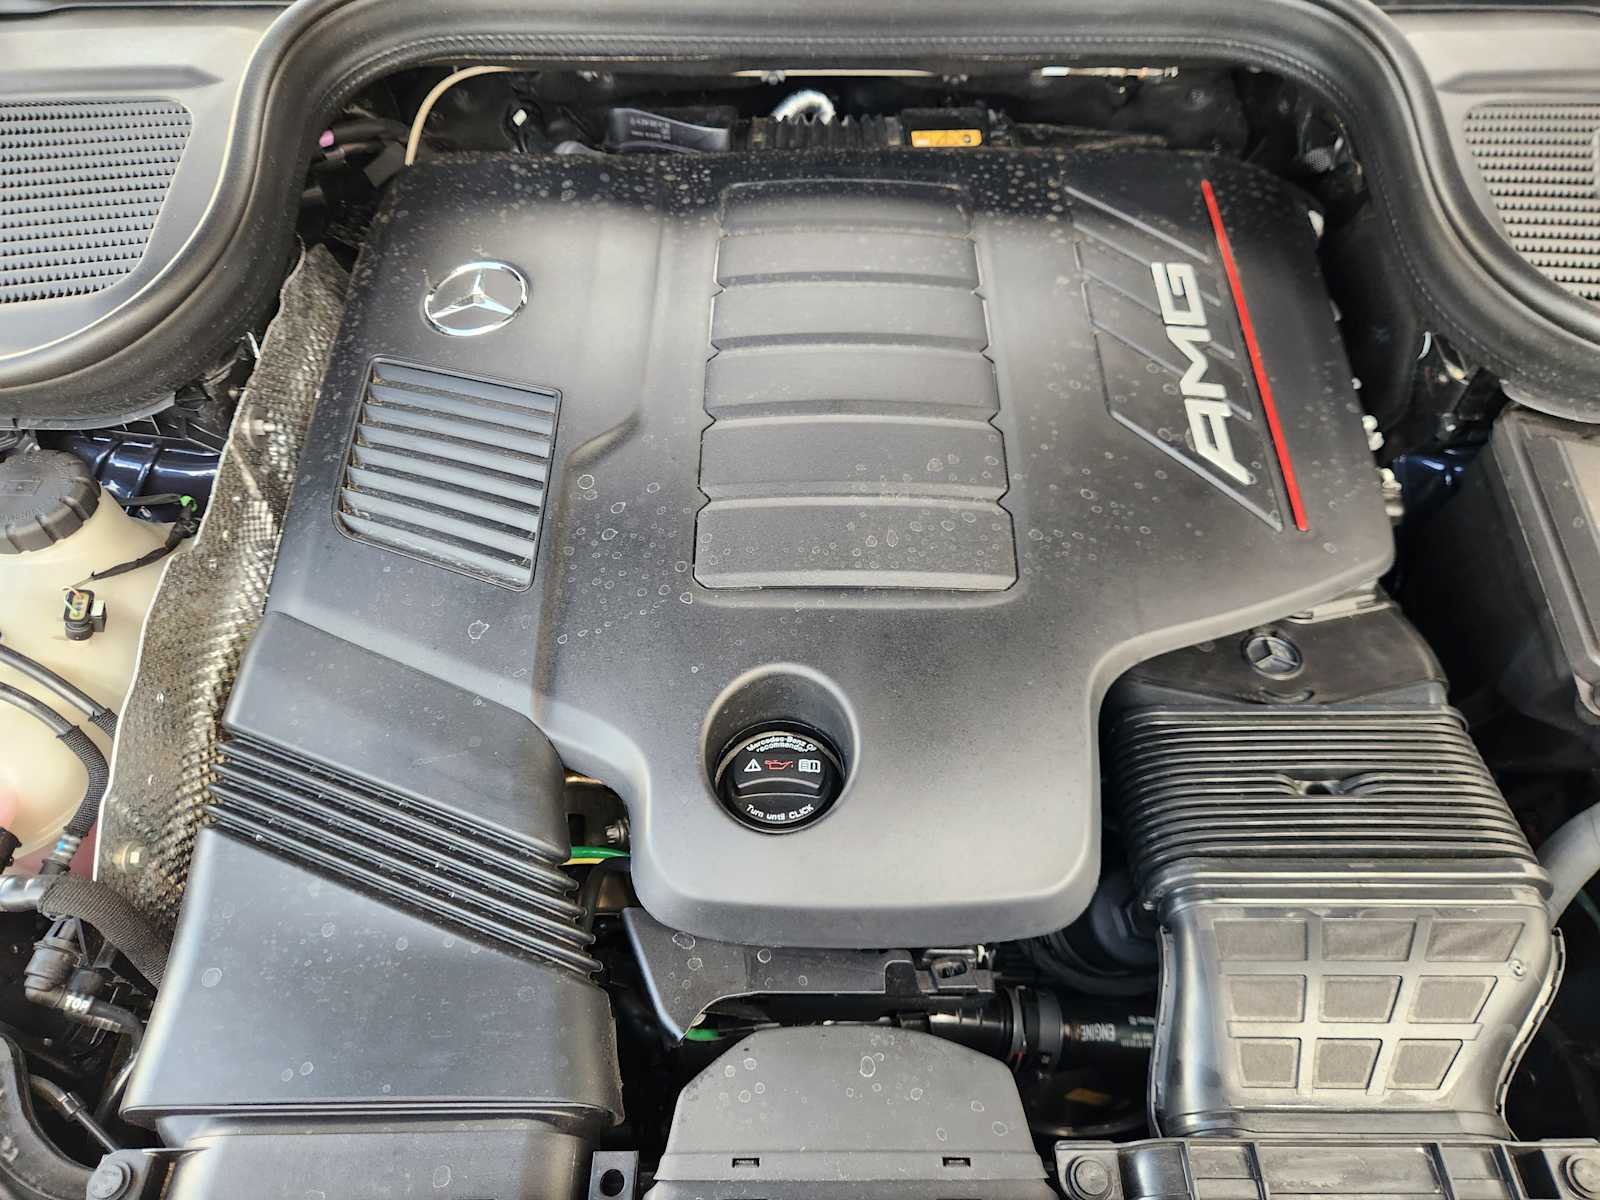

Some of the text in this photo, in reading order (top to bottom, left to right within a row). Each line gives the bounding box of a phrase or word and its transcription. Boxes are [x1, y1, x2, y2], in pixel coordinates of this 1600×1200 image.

[1151, 261, 1250, 485] AMG
[746, 804, 815, 820] Turn until CLICK
[1081, 1023, 1116, 1042] ENGINE
